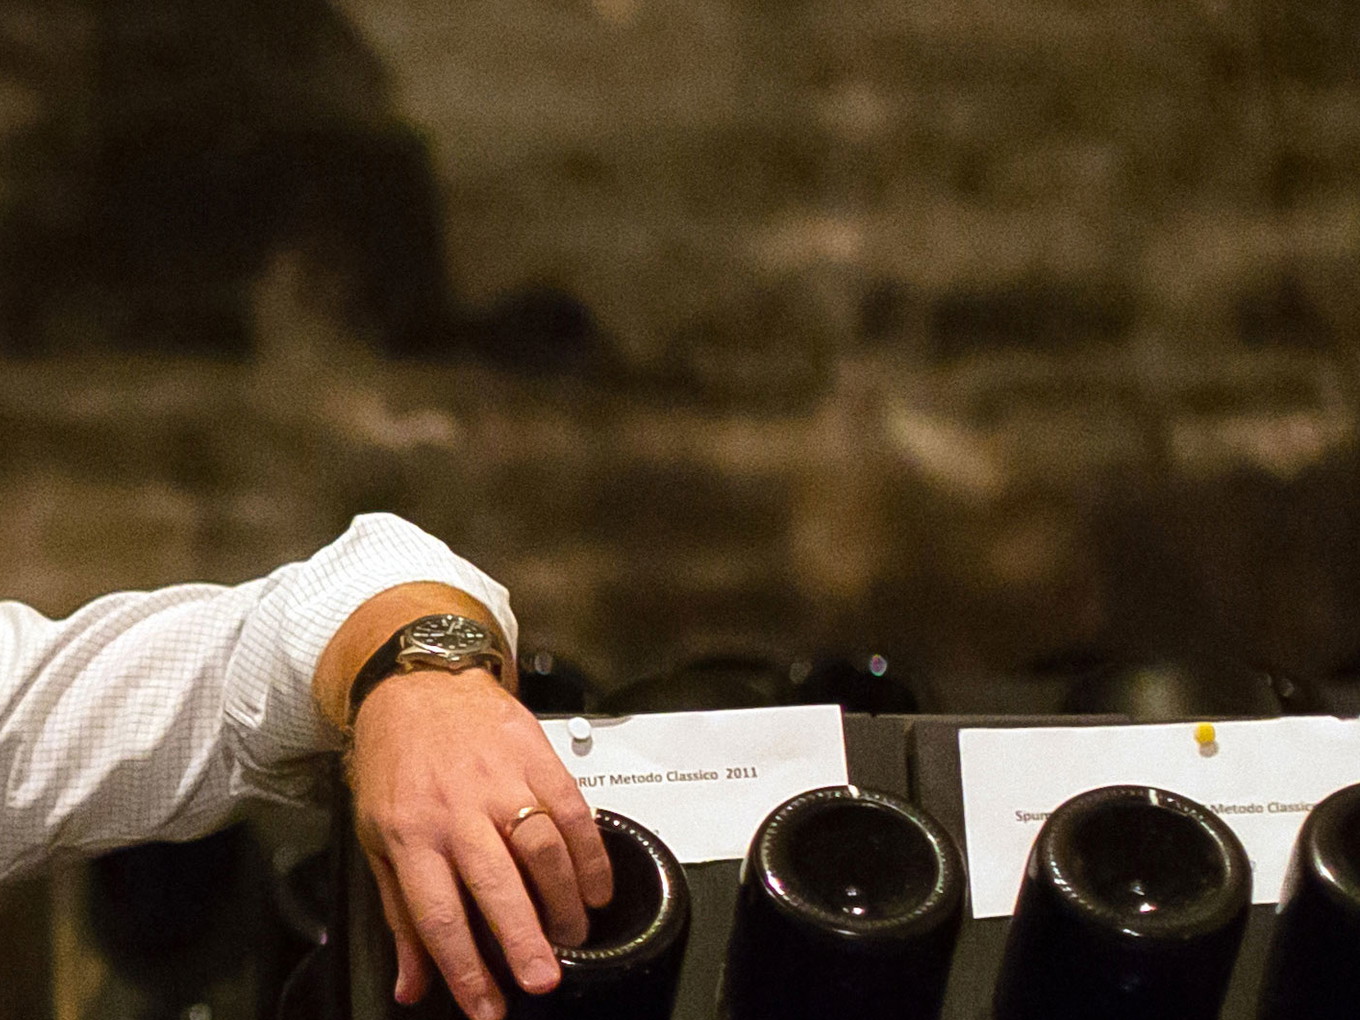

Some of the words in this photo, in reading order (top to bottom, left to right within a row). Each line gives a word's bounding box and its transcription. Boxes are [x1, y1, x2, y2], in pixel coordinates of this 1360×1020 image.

[577, 775, 606, 788] RUT
[609, 772, 663, 786] Metodo
[666, 769, 719, 783] Classico
[726, 766, 758, 780] 2011
[1210, 802, 1264, 815] Metodo
[1267, 801, 1316, 813] Classic
